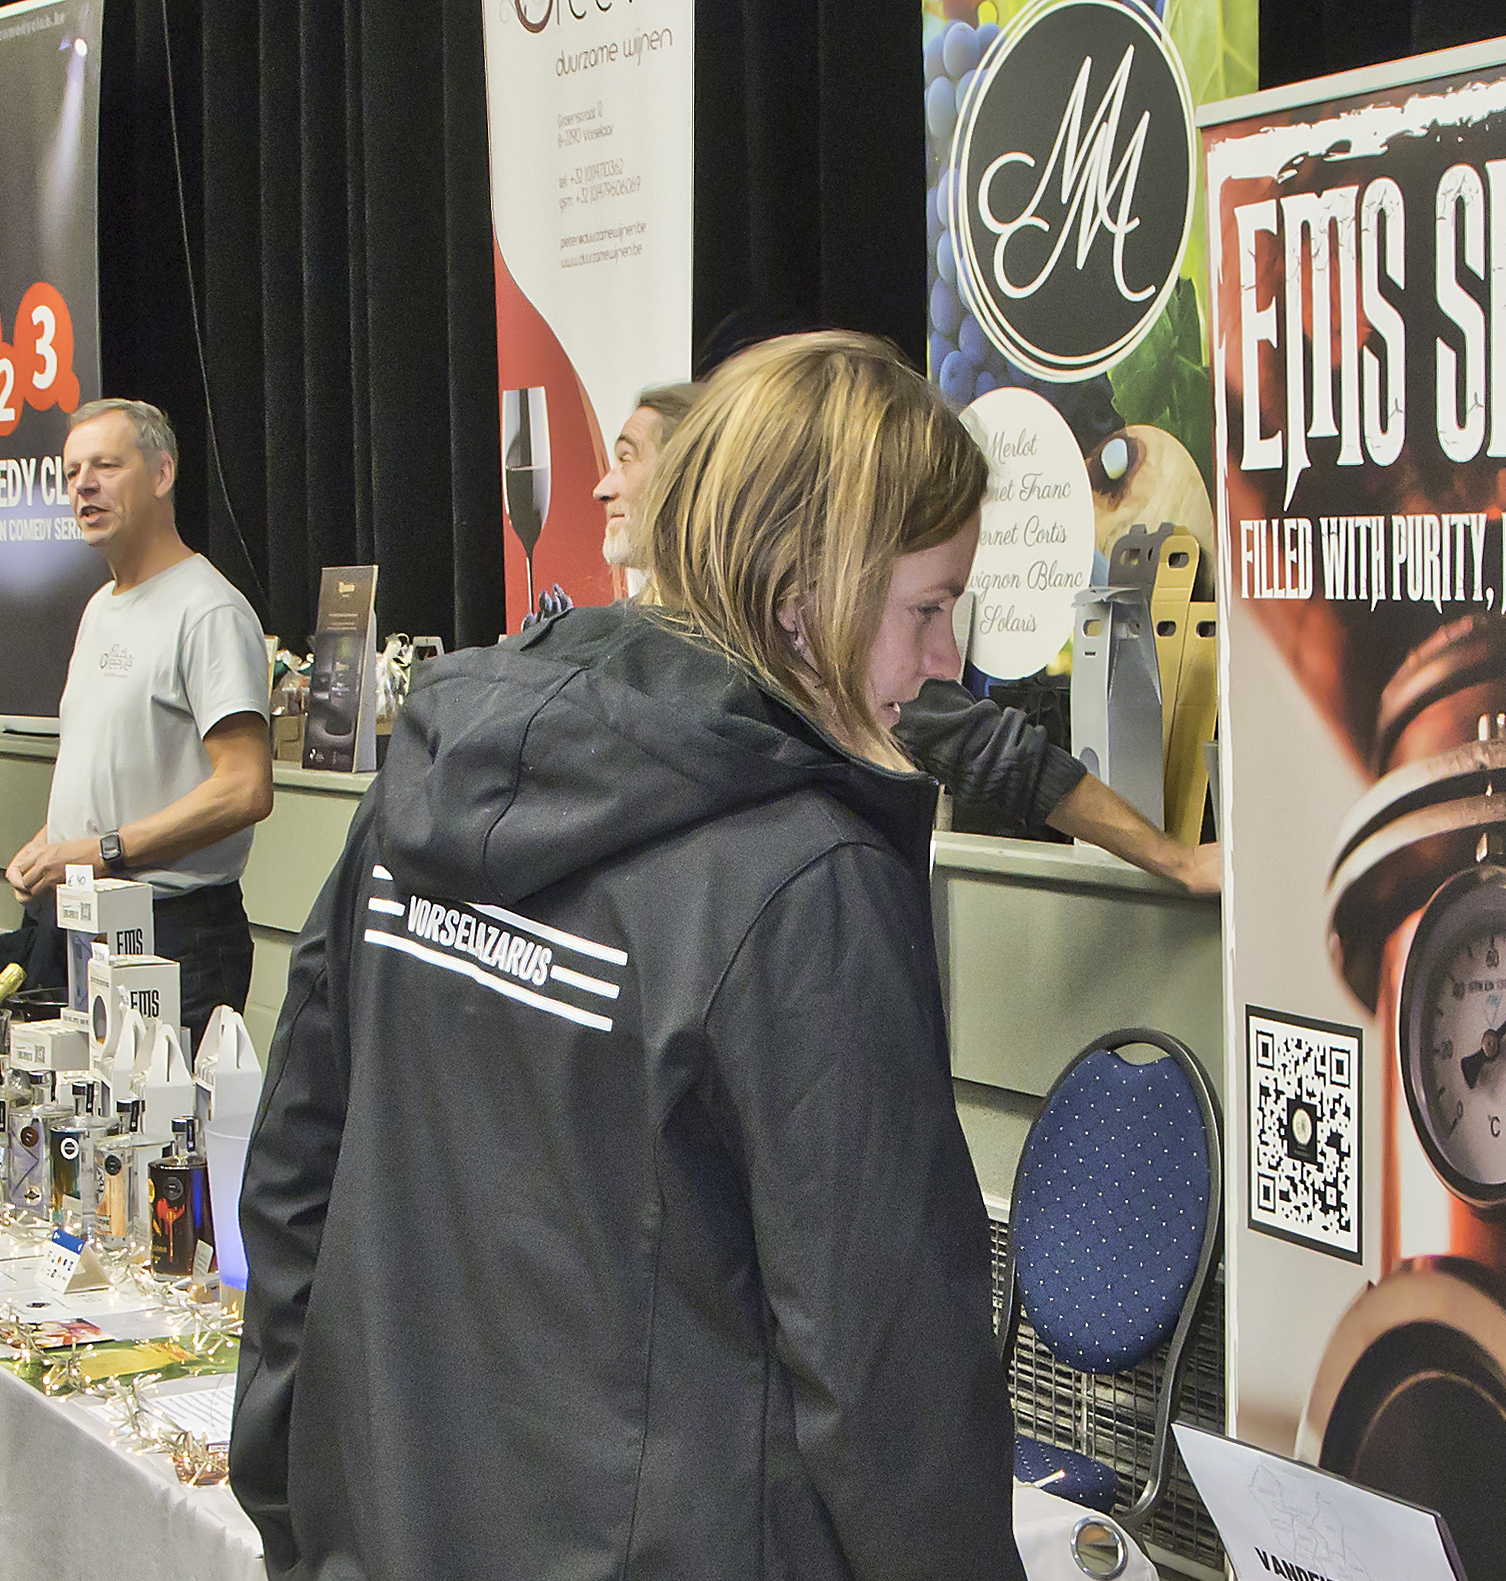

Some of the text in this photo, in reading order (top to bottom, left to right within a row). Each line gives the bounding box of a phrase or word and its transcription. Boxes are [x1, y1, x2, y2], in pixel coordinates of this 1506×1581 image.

[556, 28, 673, 76] duurzame wijnen
[1234, 176, 1405, 511] EMS
[992, 428, 1038, 464] Merlot
[41, 456, 69, 506] CL
[994, 472, 1071, 502] net Franc
[9, 519, 52, 541] COMEDY
[980, 515, 1067, 547] ernet Cortis
[1027, 560, 1083, 591] Blanc
[1240, 517, 1313, 600] FILLED
[1320, 515, 1387, 611] WITH
[1392, 512, 1494, 613] PURITY,
[980, 604, 1038, 635] Solaris
[130, 988, 160, 1019] EMS
